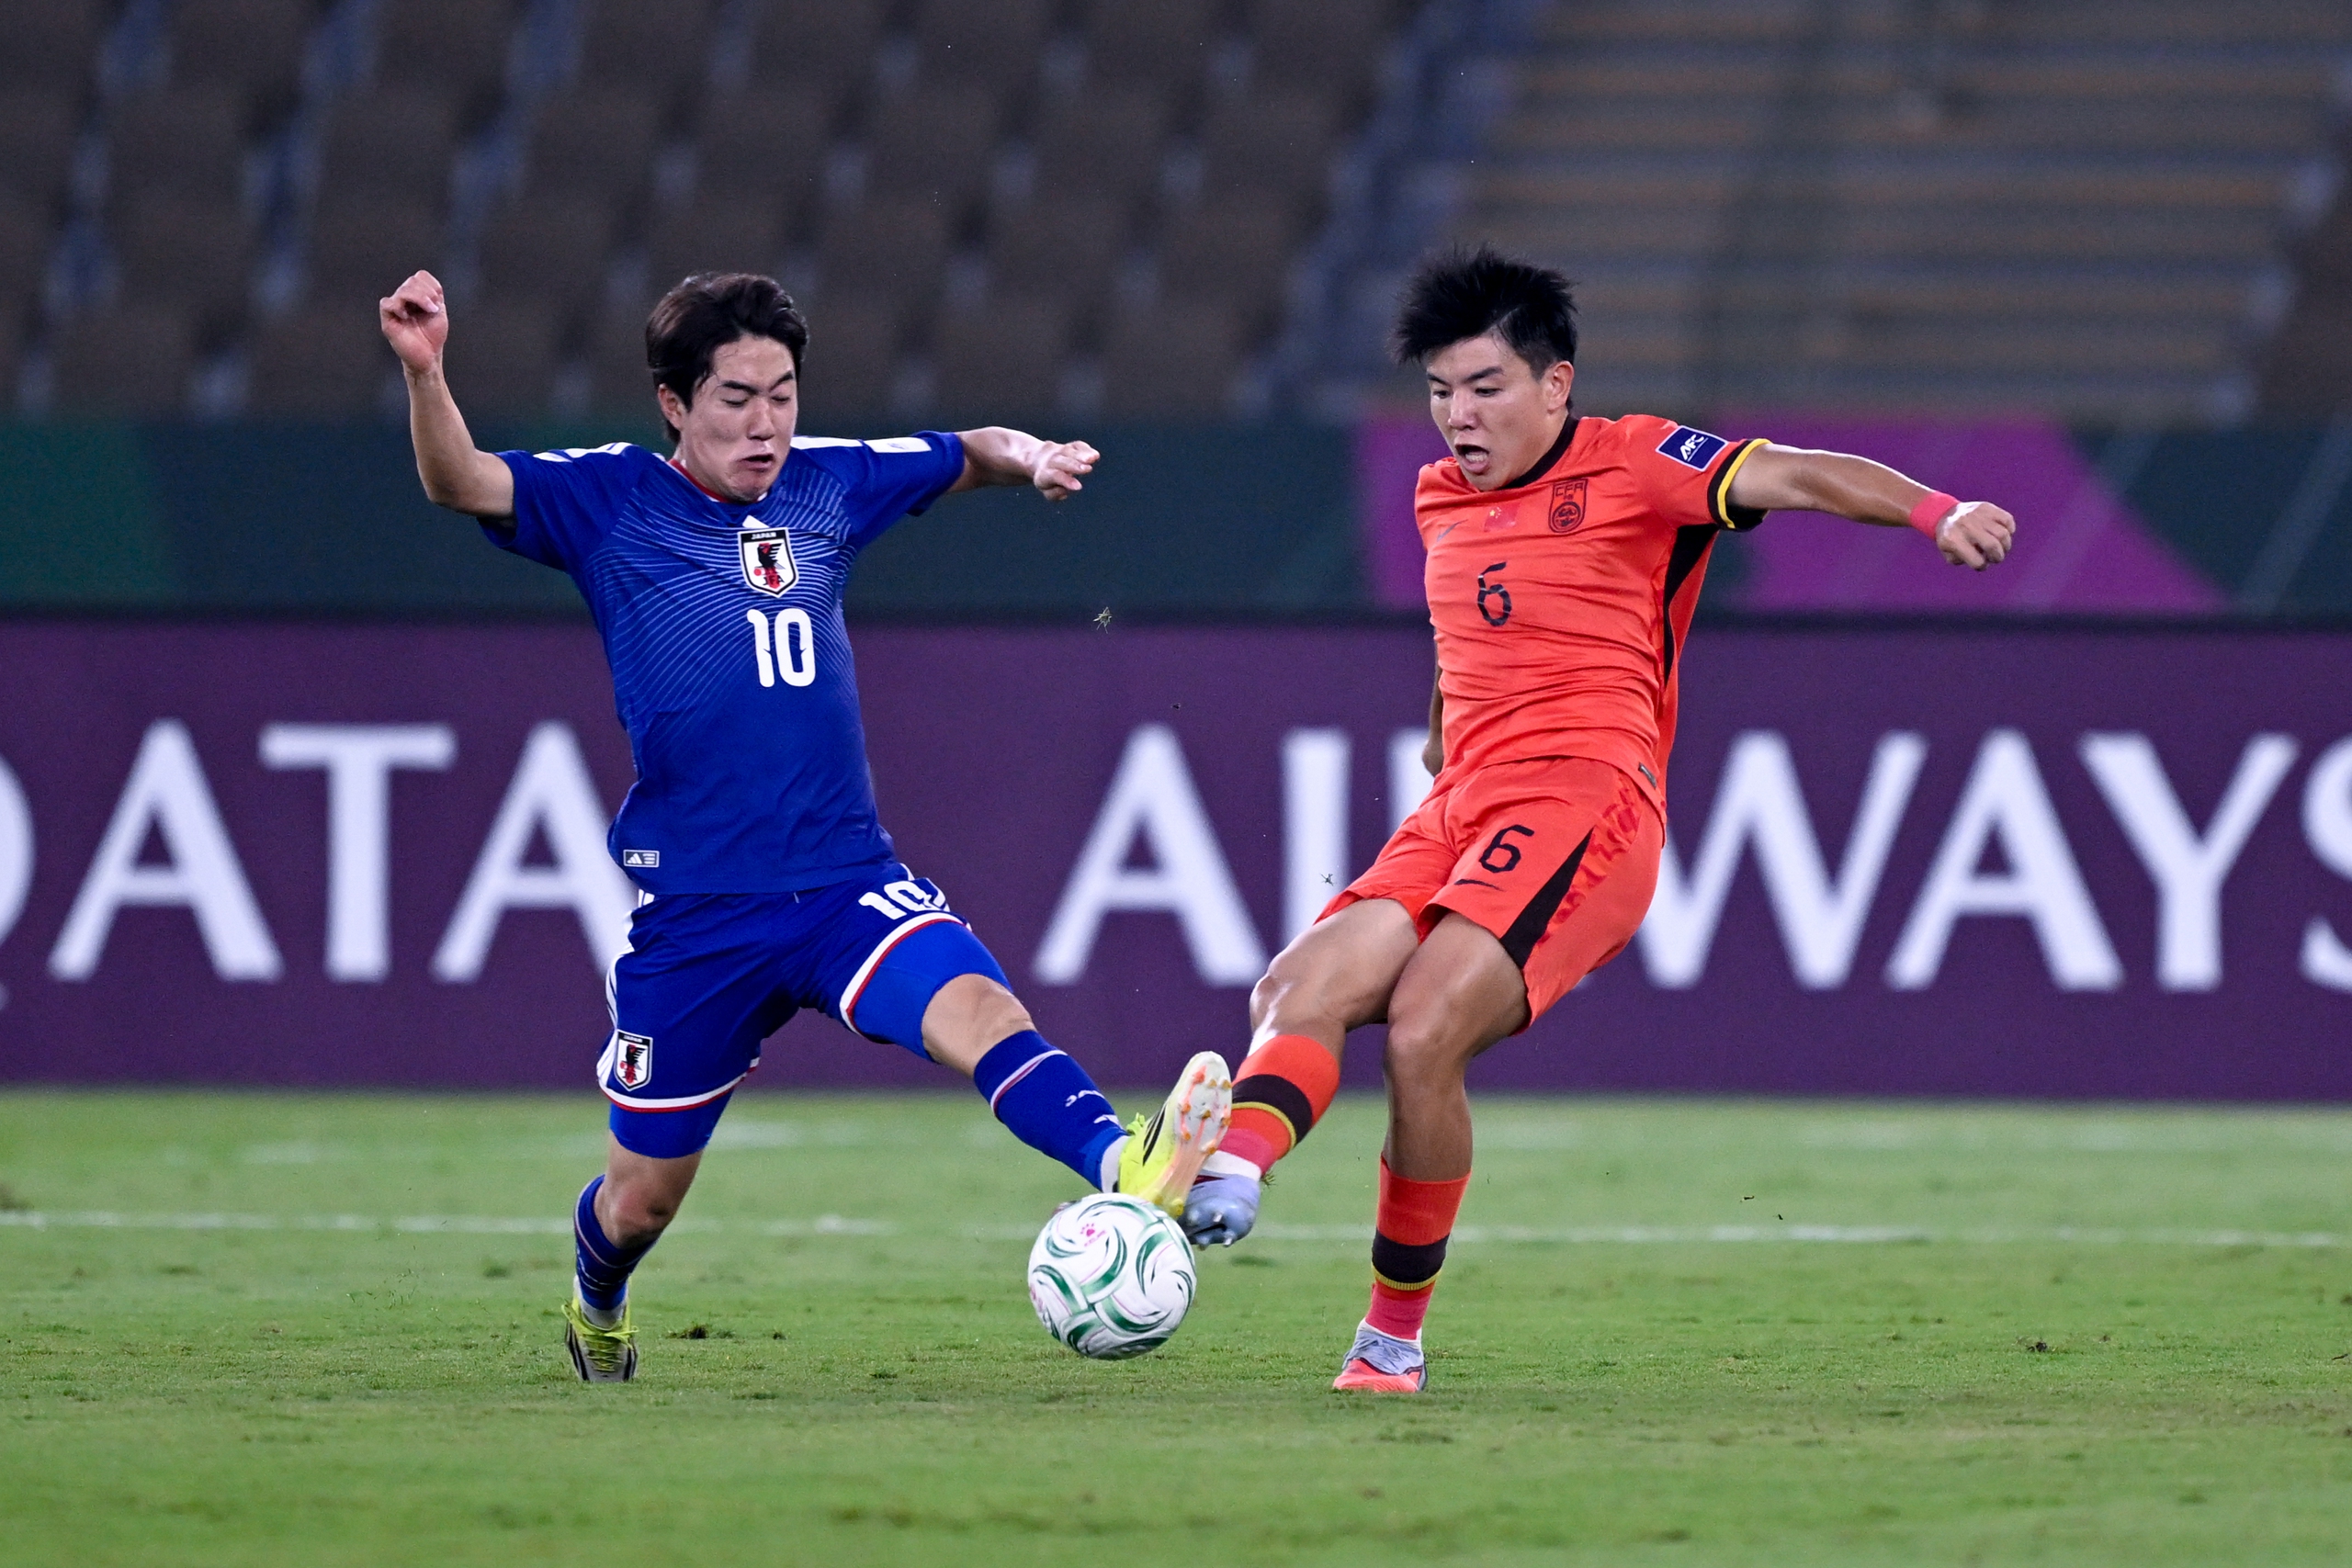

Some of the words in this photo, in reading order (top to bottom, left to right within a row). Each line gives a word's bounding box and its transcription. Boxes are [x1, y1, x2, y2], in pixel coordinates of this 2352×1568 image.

[1680, 434, 1705, 461] AFC
[1555, 482, 1584, 497] CFA
[751, 532, 777, 540] JAPAN
[1477, 561, 1512, 627] 6
[747, 608, 816, 688] 10
[0, 717, 636, 983] ATA
[1033, 722, 2352, 994] AIWAY
[1478, 824, 1535, 874] 6
[858, 880, 937, 920] 10
